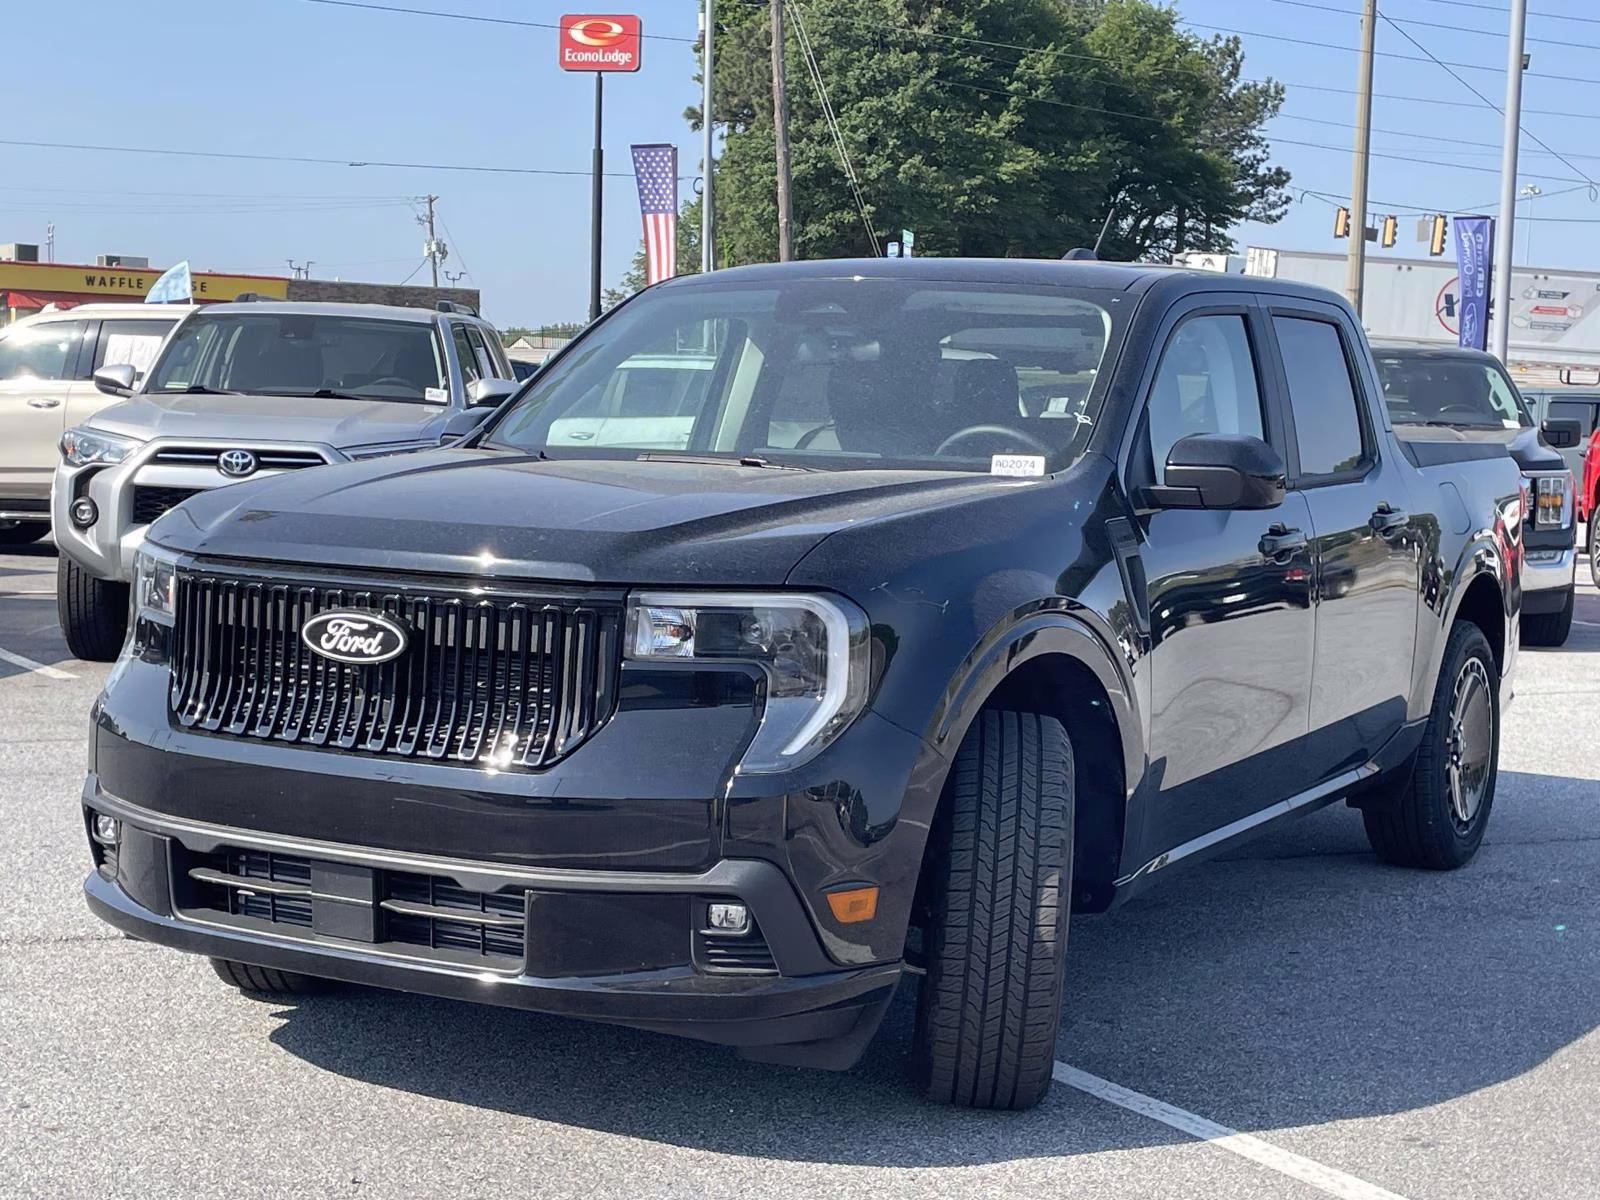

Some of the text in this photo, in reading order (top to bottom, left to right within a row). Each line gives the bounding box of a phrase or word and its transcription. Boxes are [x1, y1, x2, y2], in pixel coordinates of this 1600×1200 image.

[565, 48, 632, 65] EconoLodge
[85, 275, 144, 289] WAFFLE
[995, 459, 1036, 470] AD2074
[320, 619, 385, 655] Ford
